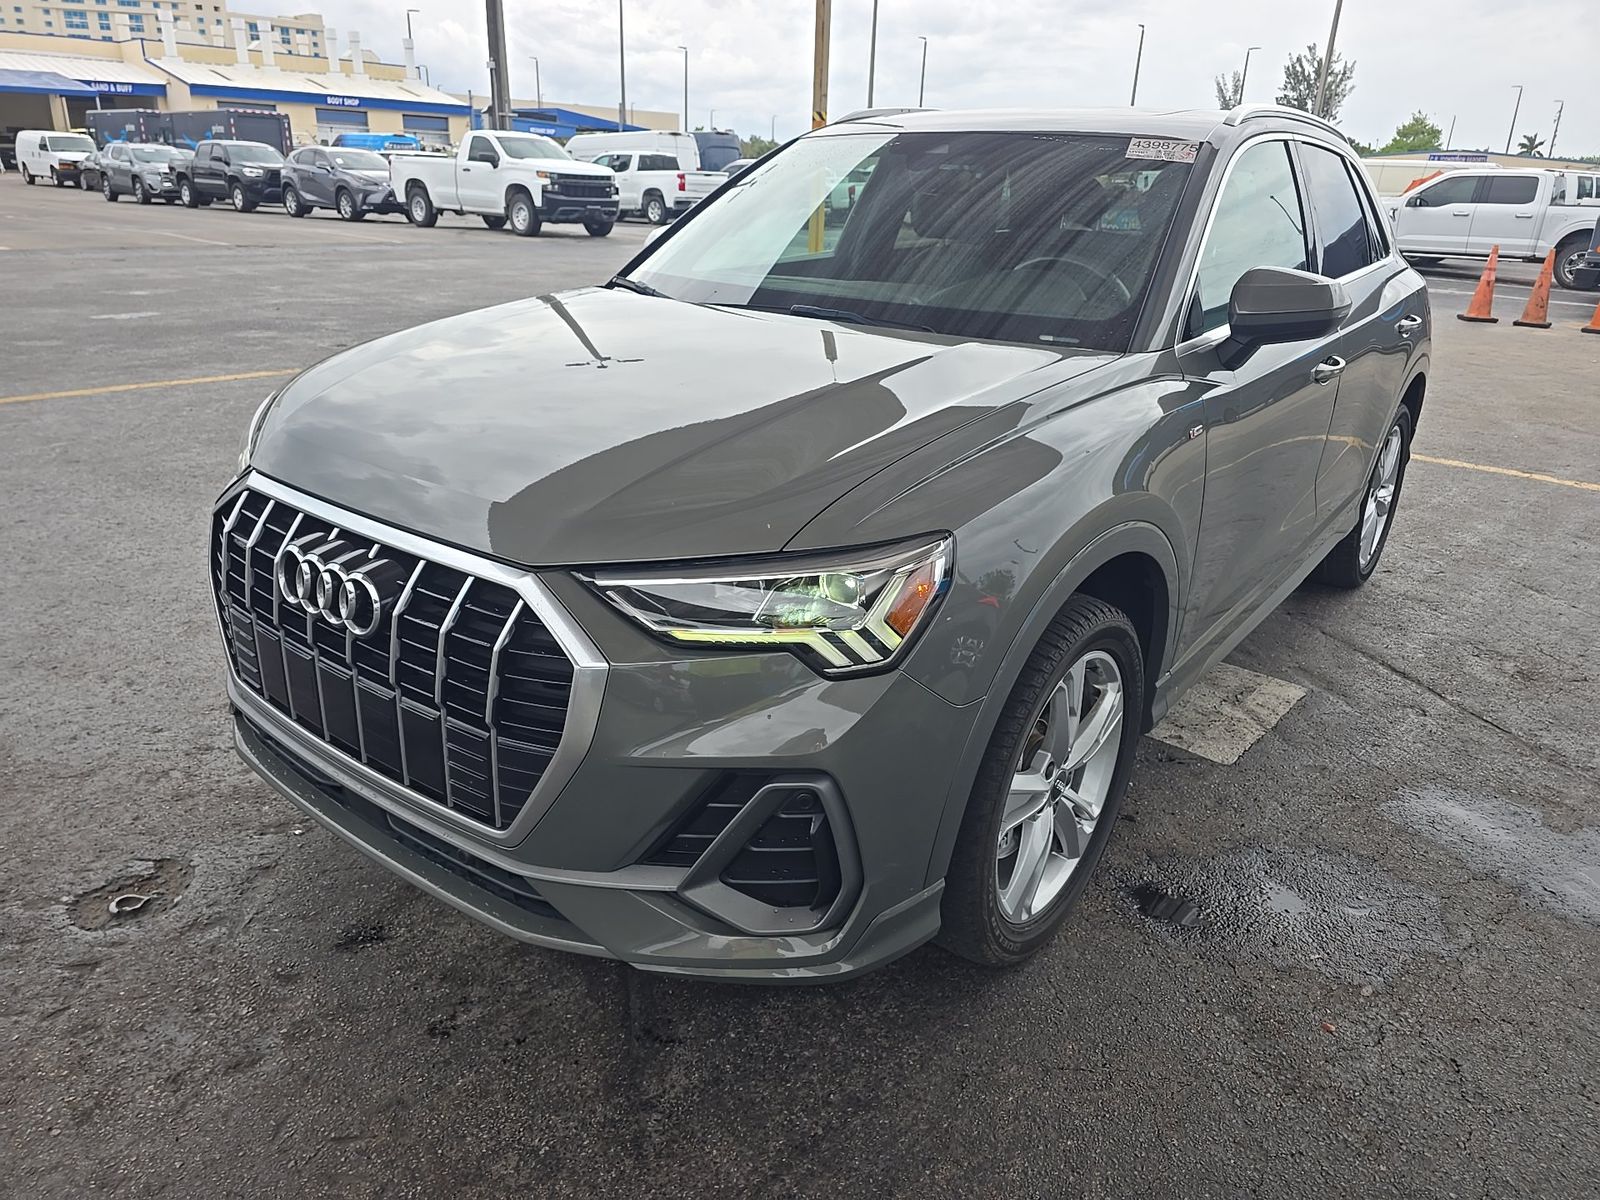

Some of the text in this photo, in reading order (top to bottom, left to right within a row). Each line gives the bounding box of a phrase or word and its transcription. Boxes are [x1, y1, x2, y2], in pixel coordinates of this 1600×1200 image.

[327, 96, 359, 105] BODY SHOP
[1133, 141, 1199, 152] 4398775
